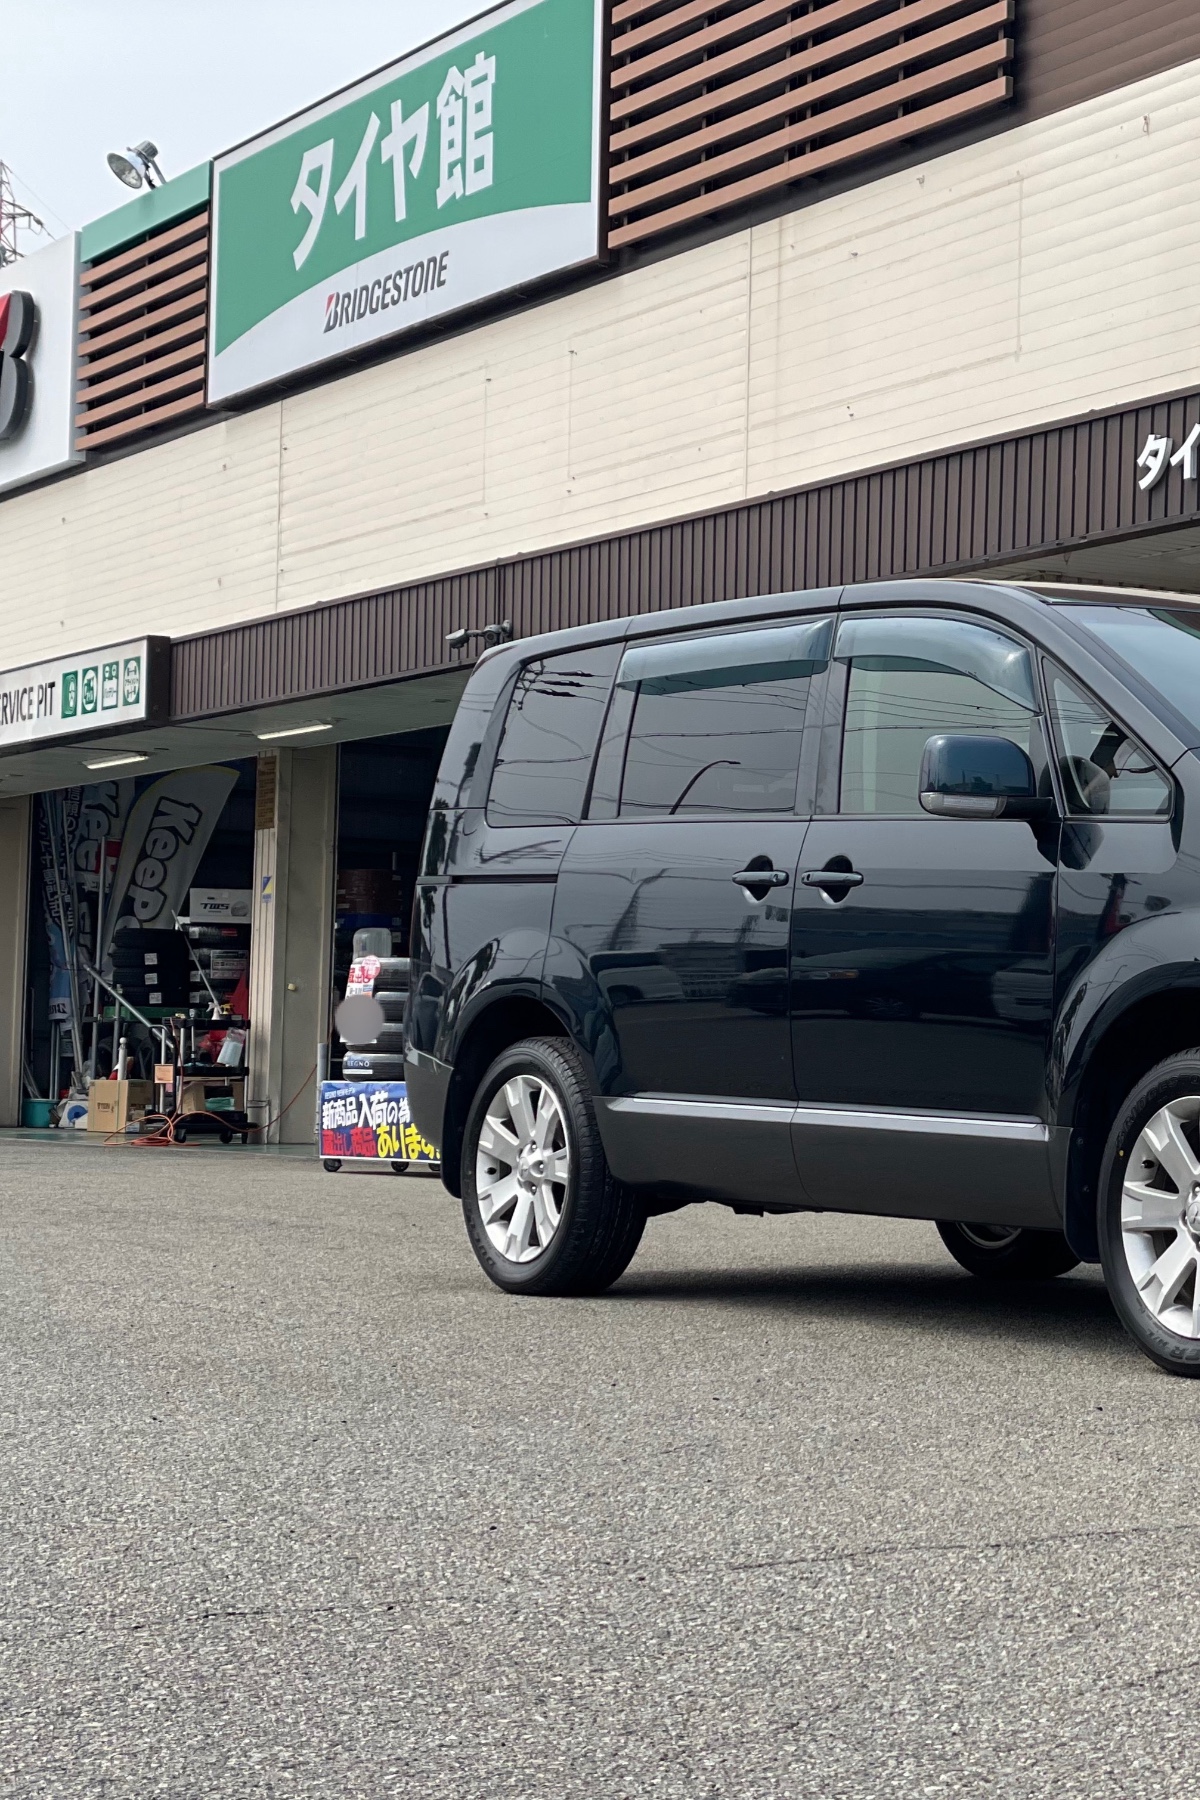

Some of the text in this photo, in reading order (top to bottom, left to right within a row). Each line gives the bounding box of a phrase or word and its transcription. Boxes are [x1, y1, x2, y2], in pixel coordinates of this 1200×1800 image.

[290, 51, 496, 271] タイヤ館
[323, 250, 449, 333] BRIDGESTONE
[37, 681, 55, 718] PIT
